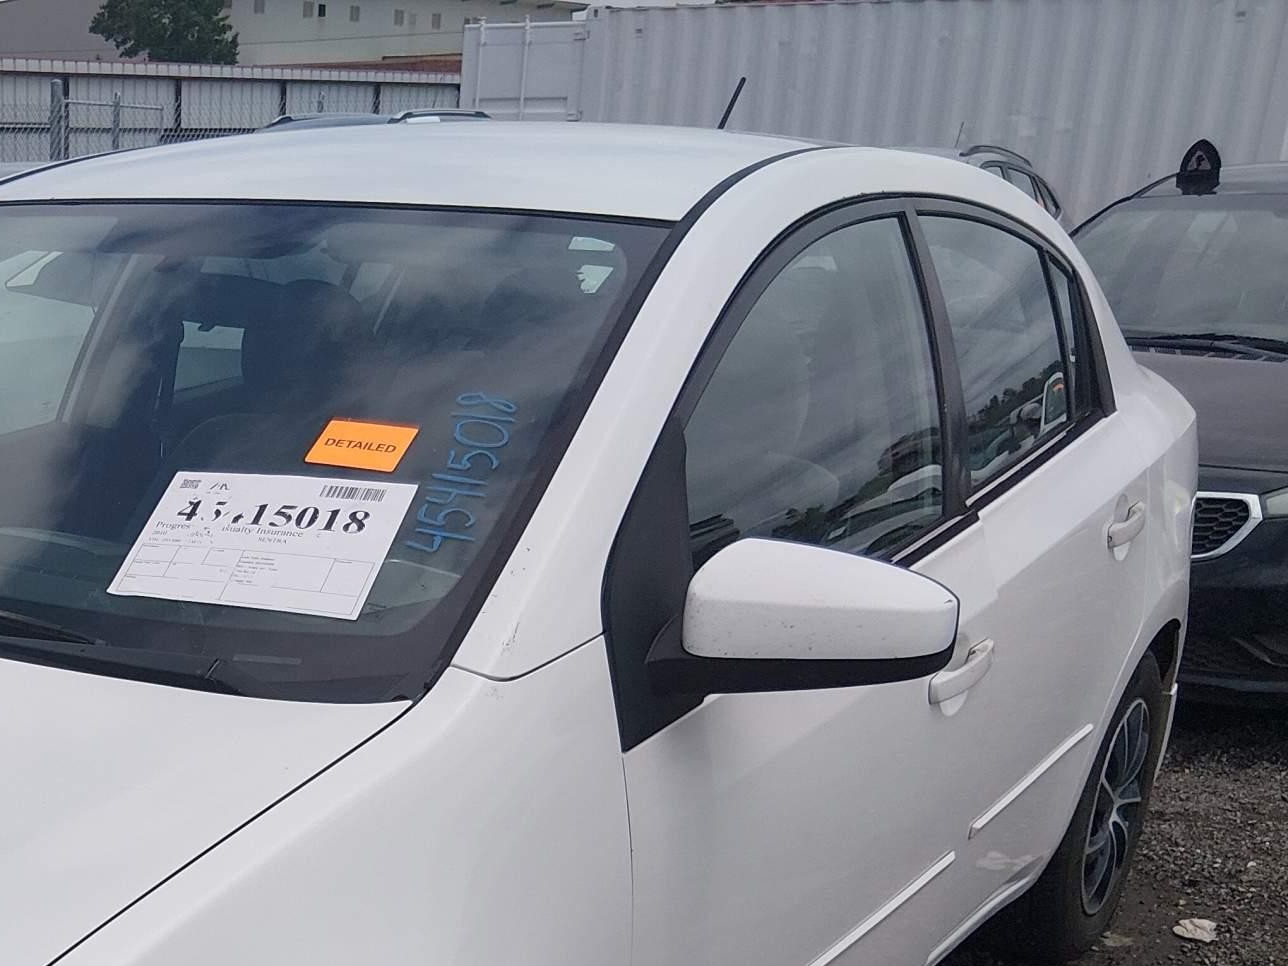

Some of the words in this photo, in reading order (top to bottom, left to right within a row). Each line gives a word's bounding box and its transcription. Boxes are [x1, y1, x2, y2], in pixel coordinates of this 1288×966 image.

[324, 438, 397, 454] DETAILED
[406, 392, 516, 552] 45415018
[257, 527, 304, 538] Insurance
